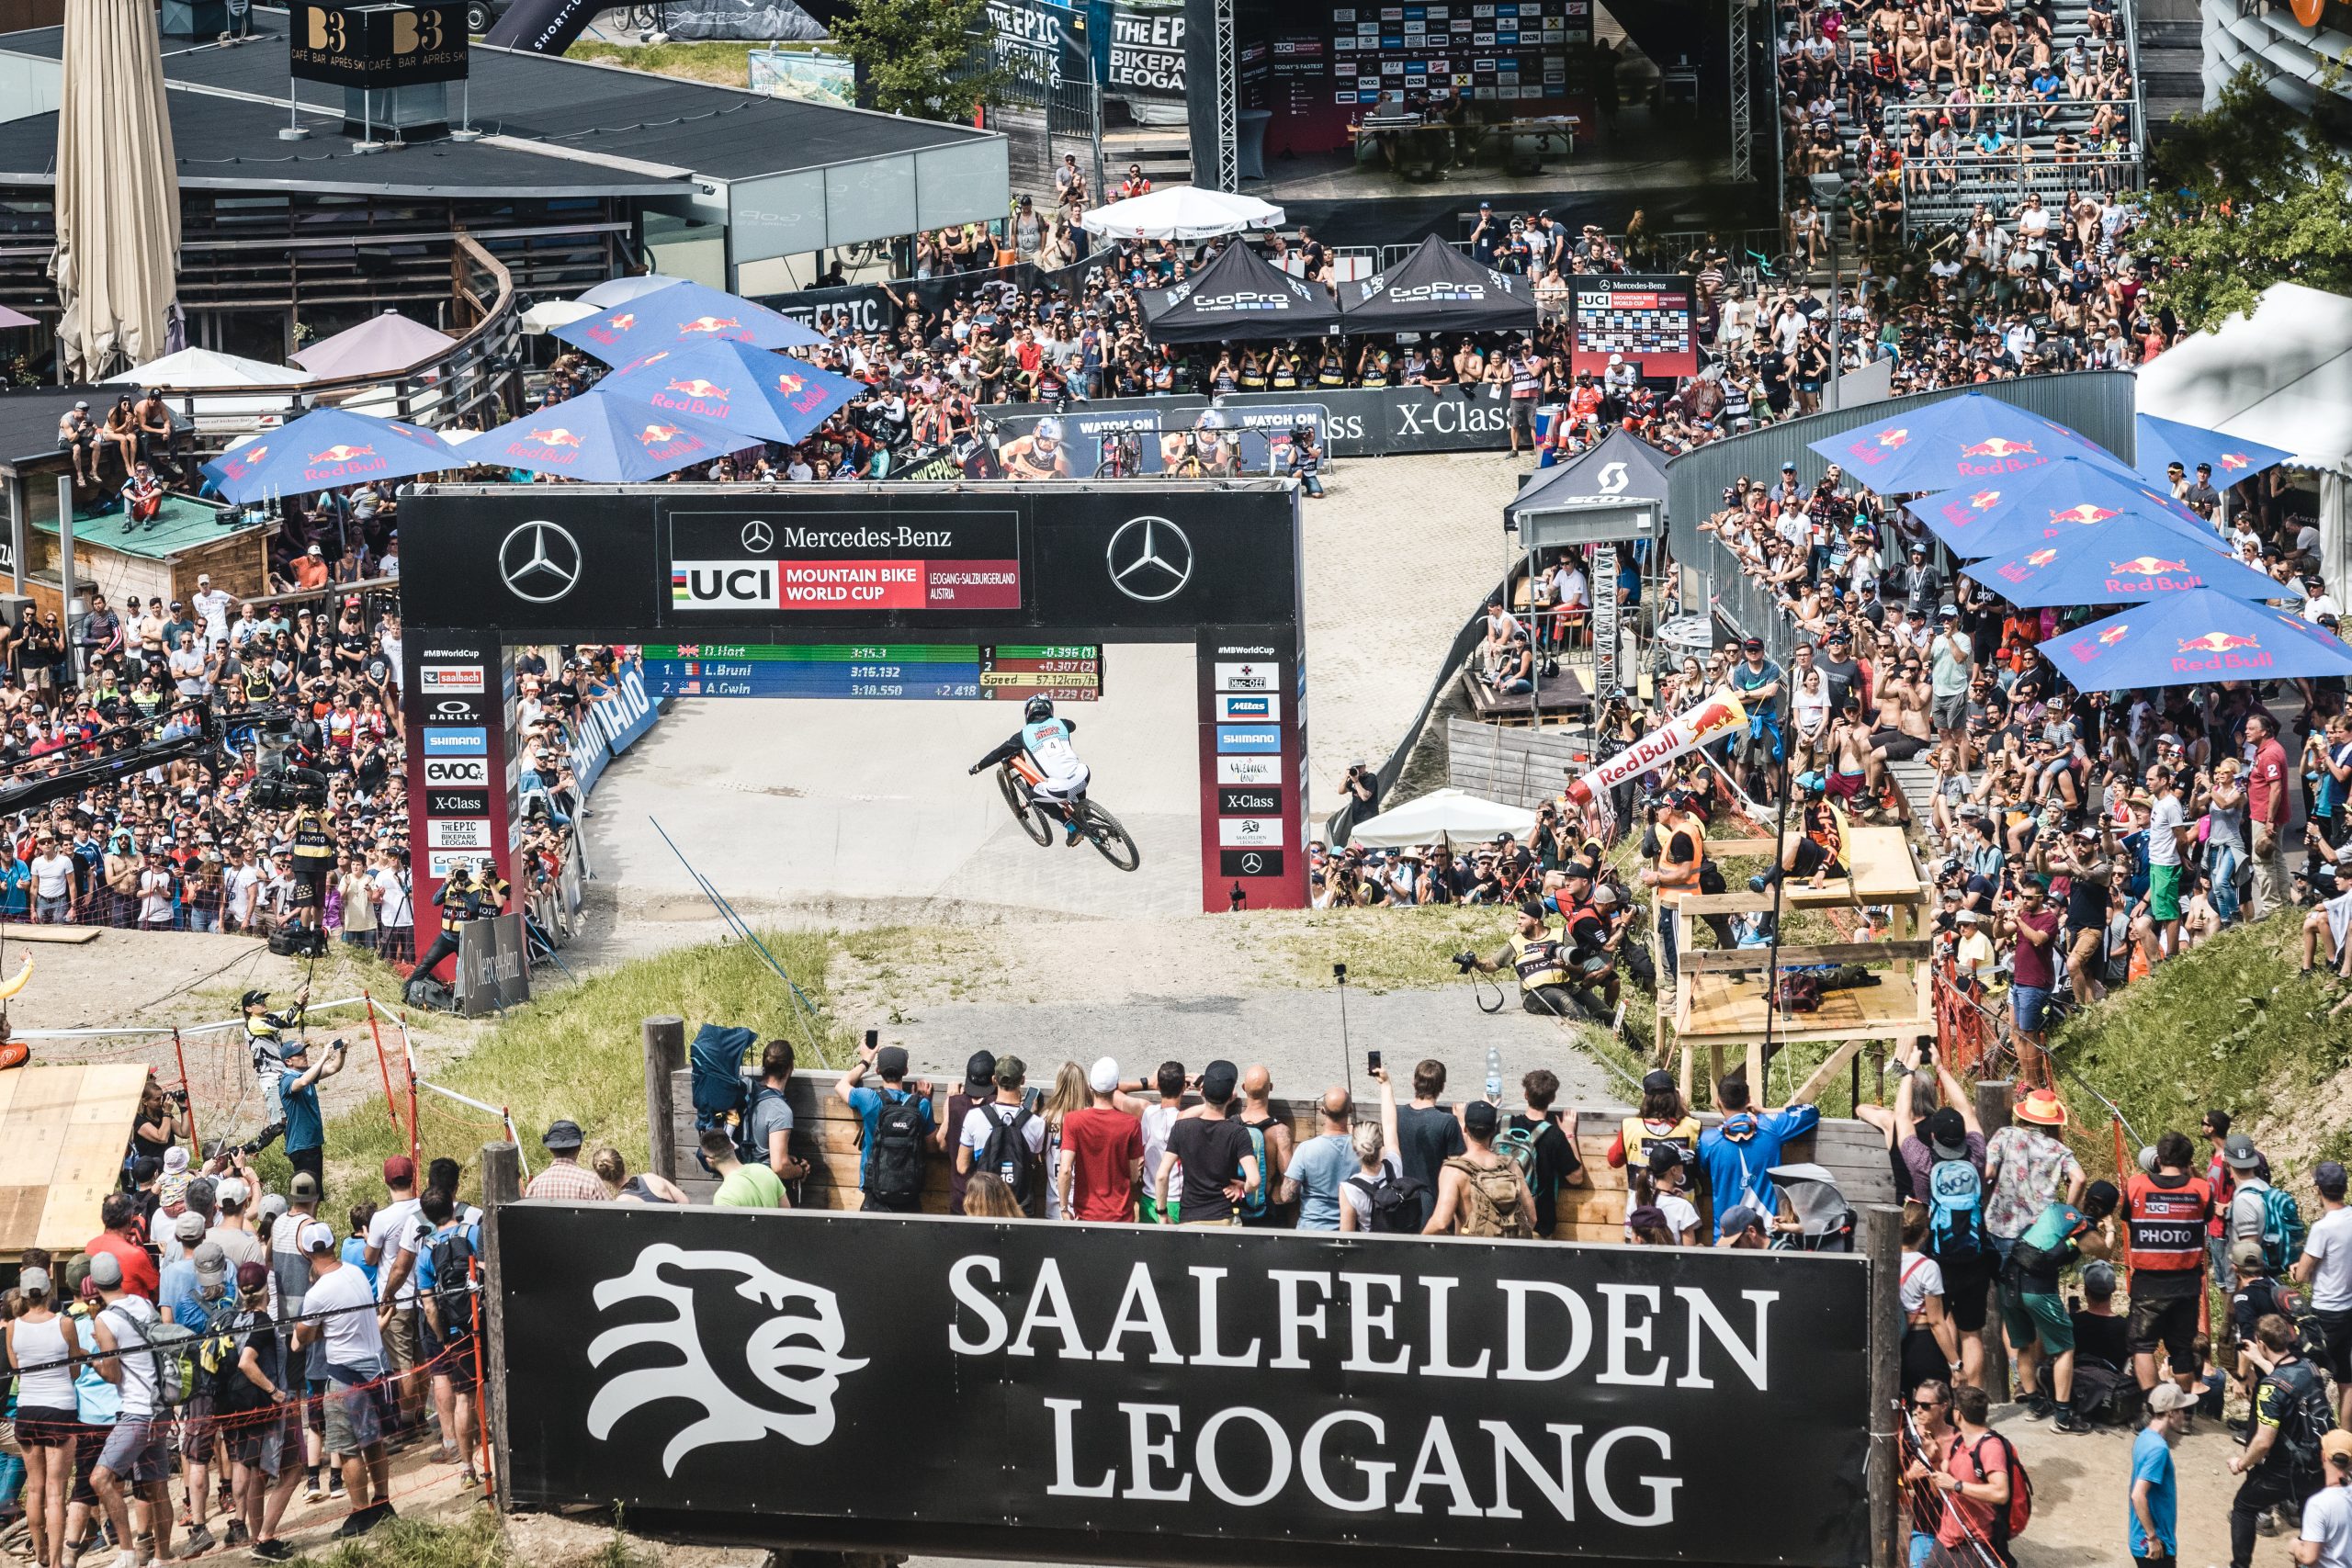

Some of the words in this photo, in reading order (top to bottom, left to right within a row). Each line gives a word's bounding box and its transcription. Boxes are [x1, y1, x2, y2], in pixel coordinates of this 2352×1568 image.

[308, 6, 345, 52] B3
[393, 9, 443, 54] B3
[986, 7, 1011, 29] THE
[1013, 6, 1060, 45] EPIC
[1114, 20, 1150, 42] THE
[1278, 43, 1294, 51] UCI
[291, 48, 308, 62] CAFÉ
[312, 52, 326, 64] BAR
[331, 55, 353, 69] APRÈS
[354, 61, 366, 71] SKI
[368, 57, 391, 71] CAFÉ
[399, 57, 416, 68] BAR
[423, 52, 451, 65] APRÈS
[453, 51, 467, 62] SKI
[1111, 50, 1185, 73] BIKEPA
[1109, 67, 1186, 90] LEOGA
[1389, 282, 1484, 297] GoPro
[1612, 281, 1666, 290] Mercedes-Benz
[1193, 292, 1288, 306] GoPro
[1583, 295, 1609, 305] UCI
[650, 393, 689, 411] Red
[691, 400, 730, 419] Bull
[1132, 419, 1153, 430] ON
[1242, 415, 1293, 426] WATCH
[1296, 413, 1317, 424] ON
[505, 442, 539, 457] Red
[541, 449, 579, 464] Bull
[304, 465, 345, 482] Red
[349, 457, 388, 475] Bull
[1957, 462, 2004, 477] Red
[785, 526, 952, 548] Mercedes-Benz
[691, 569, 771, 600] UCI
[786, 569, 878, 582] MOUNTAIN
[881, 569, 917, 582] BIKE
[930, 571, 1016, 586] LEOGANG-SALZBURGERLAND
[2104, 577, 2154, 594] Red
[2157, 575, 2203, 591] Bull
[786, 586, 848, 600] WORLD
[851, 585, 885, 600] CUP
[930, 588, 955, 600] AUSTRIA
[424, 649, 480, 660] #MBWorldCup
[704, 646, 746, 657] D.Hart
[984, 648, 991, 658] 1
[1217, 647, 1275, 656] #MBWorldCup
[984, 661, 992, 671] 2
[1038, 661, 1079, 671] +0.307
[2170, 656, 2222, 673] Red
[2226, 651, 2273, 670] Bull
[441, 671, 480, 682] saalbach
[663, 664, 673, 675] 1.
[706, 664, 752, 676] L.Bruni
[851, 666, 900, 678] 3:16.132
[983, 674, 1018, 684] Speed
[1036, 674, 1095, 687] 57.12km/h
[1231, 679, 1265, 687] Muc-Off
[662, 682, 673, 694] 2.
[706, 682, 751, 694] A.Gwin
[934, 685, 977, 696] +2.418
[984, 689, 993, 700] 4
[430, 737, 481, 746] SHIMANO
[1223, 735, 1274, 743] SHIMANO
[1597, 751, 1640, 786] Red
[1637, 728, 1679, 763] Bull
[427, 763, 481, 780] evoc
[2267, 764, 2278, 778] 2
[435, 797, 481, 809] X-Class
[1227, 795, 1274, 807] X-Class
[454, 822, 477, 831] EPIC
[1001, 1173, 1014, 1184] 16
[2139, 1230, 2191, 1243] PHOTO
[948, 1254, 1781, 1393] SAALFELDEN
[1045, 1397, 1683, 1528] LEOGANG
